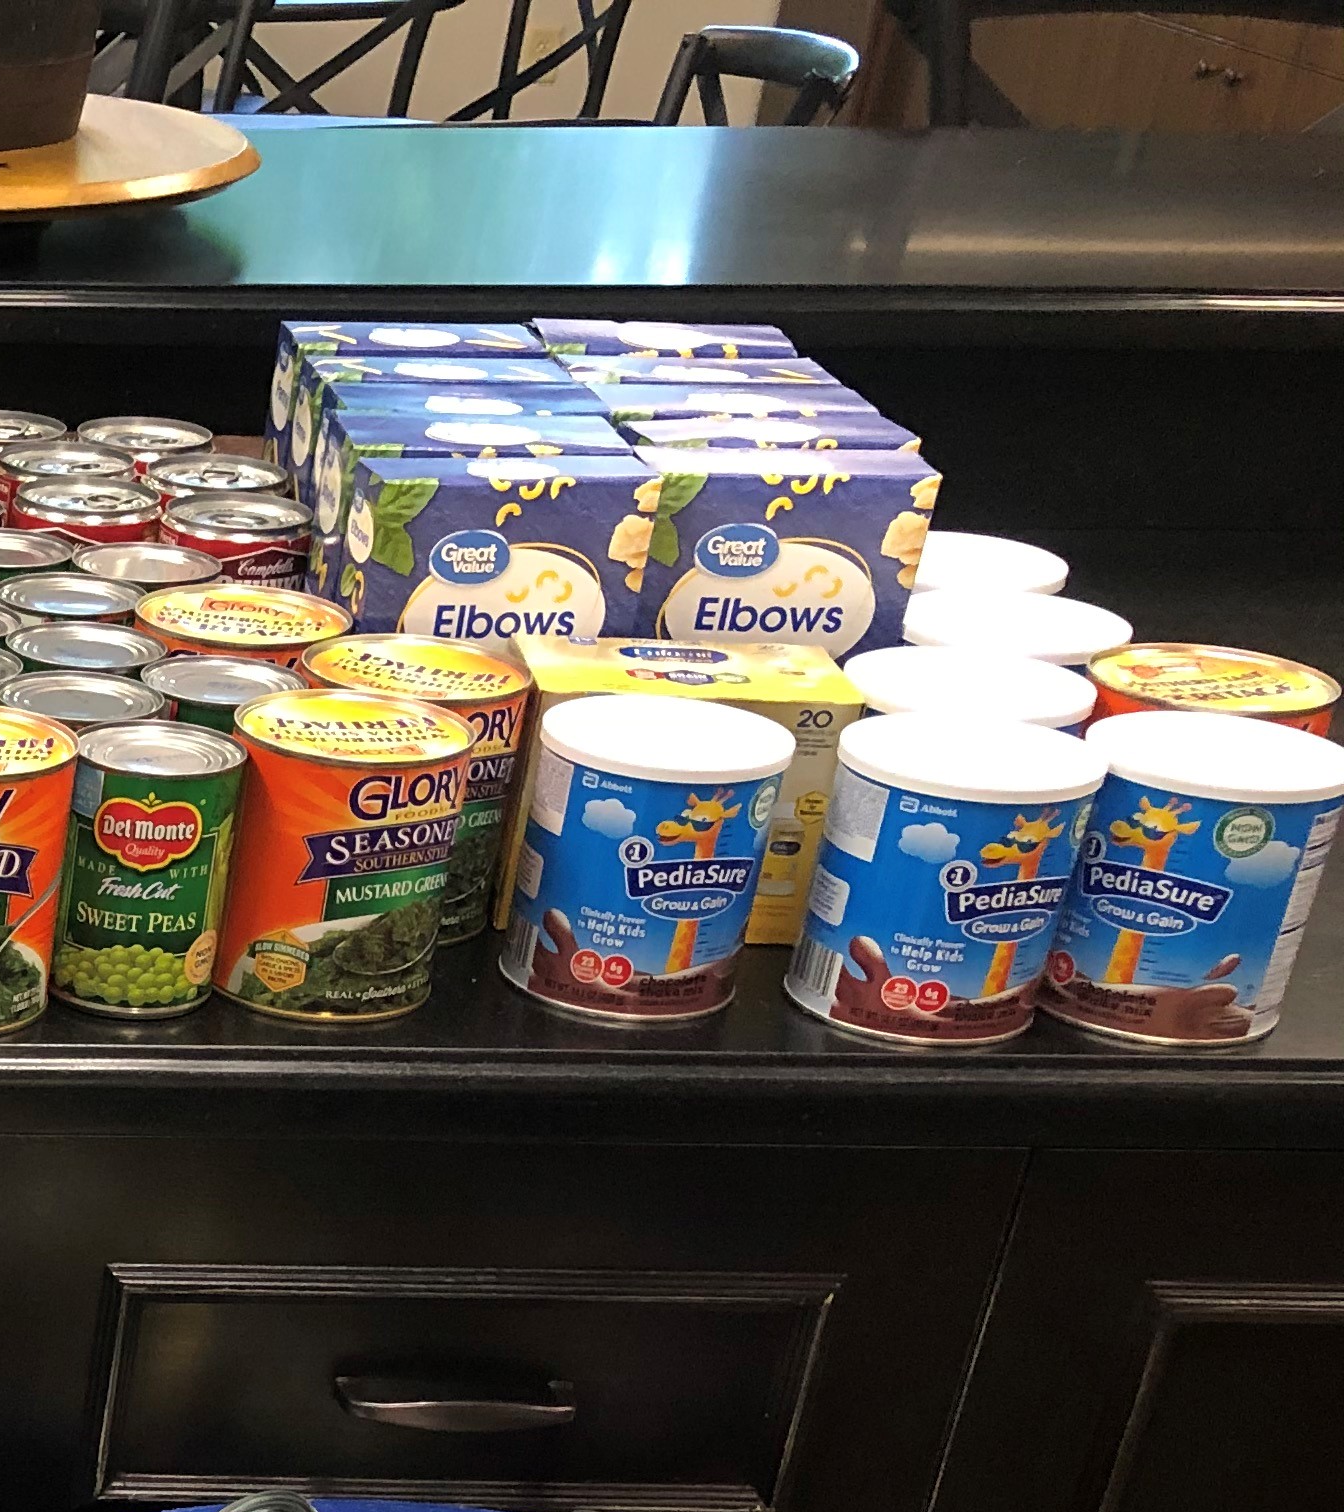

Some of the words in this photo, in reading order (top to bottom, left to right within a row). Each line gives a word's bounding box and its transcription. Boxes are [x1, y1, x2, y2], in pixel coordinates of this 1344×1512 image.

[440, 542, 496, 563] Great
[706, 534, 766, 556] Great
[452, 557, 495, 574] Value
[718, 551, 764, 568] Value
[432, 604, 576, 639] Elbows
[693, 596, 845, 634] Elbows
[796, 709, 833, 729] 20
[348, 764, 461, 822] GLORY
[102, 814, 133, 838] Del
[134, 820, 196, 841] Monte
[124, 841, 167, 860] Quality
[353, 850, 424, 873] SOUTHERN
[169, 864, 209, 881] WITH
[638, 864, 746, 889] PediaSure
[334, 879, 412, 905] MUSTARD
[958, 884, 1061, 913] PediaSure
[1089, 864, 1216, 911] PediaSure
[650, 897, 690, 912] Grow
[76, 900, 141, 934] SWEET
[146, 911, 198, 934] PEAS
[971, 920, 1008, 935] Grow
[1147, 912, 1184, 931] Gain
[591, 933, 625, 949] Grow
